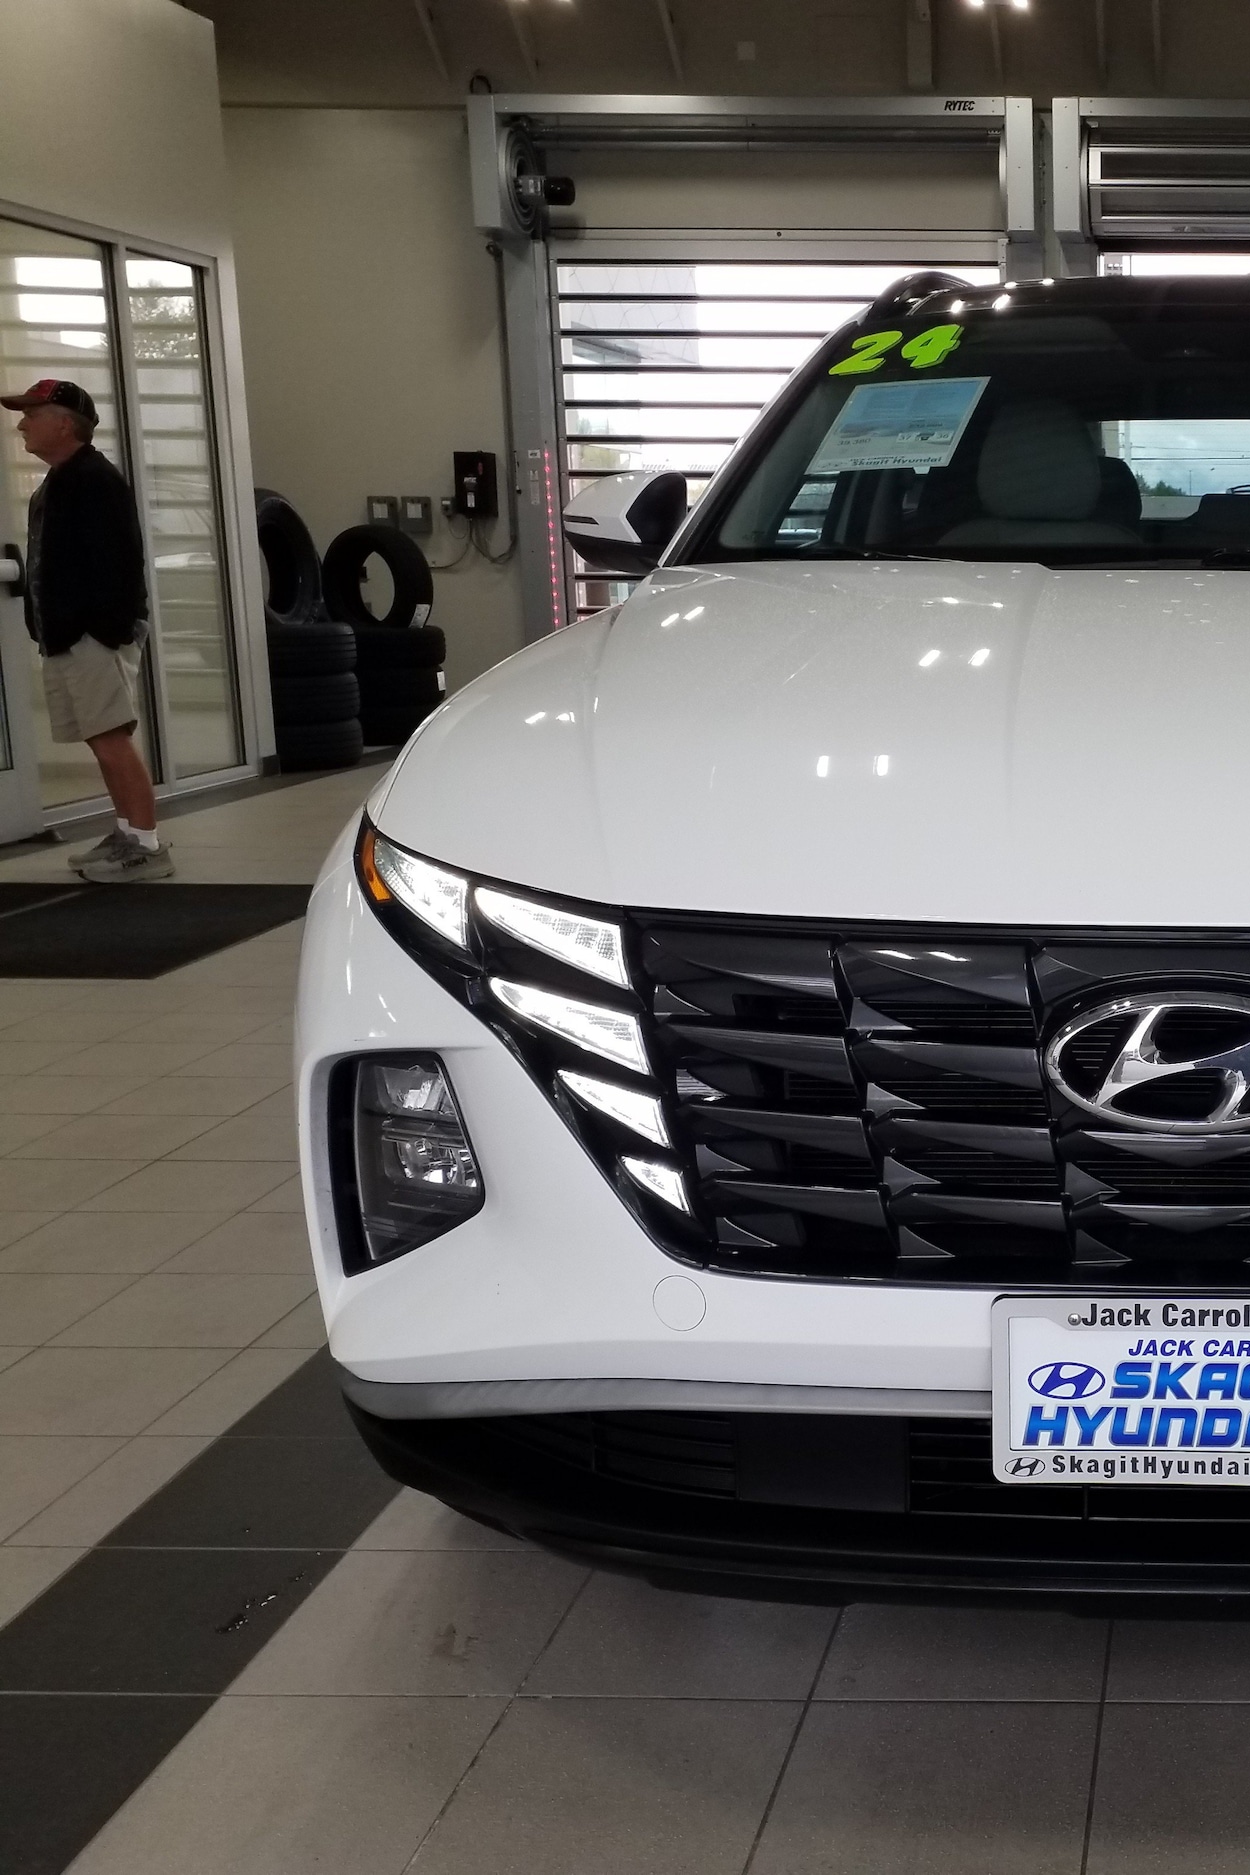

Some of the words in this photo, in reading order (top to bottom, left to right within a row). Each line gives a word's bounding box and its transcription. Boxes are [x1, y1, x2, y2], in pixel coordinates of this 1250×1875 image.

[944, 100, 975, 111] RYTEC
[828, 324, 965, 376] 24
[893, 456, 942, 465] Hyundai
[1081, 1303, 1152, 1327] Jack
[1128, 1339, 1195, 1358] JACK
